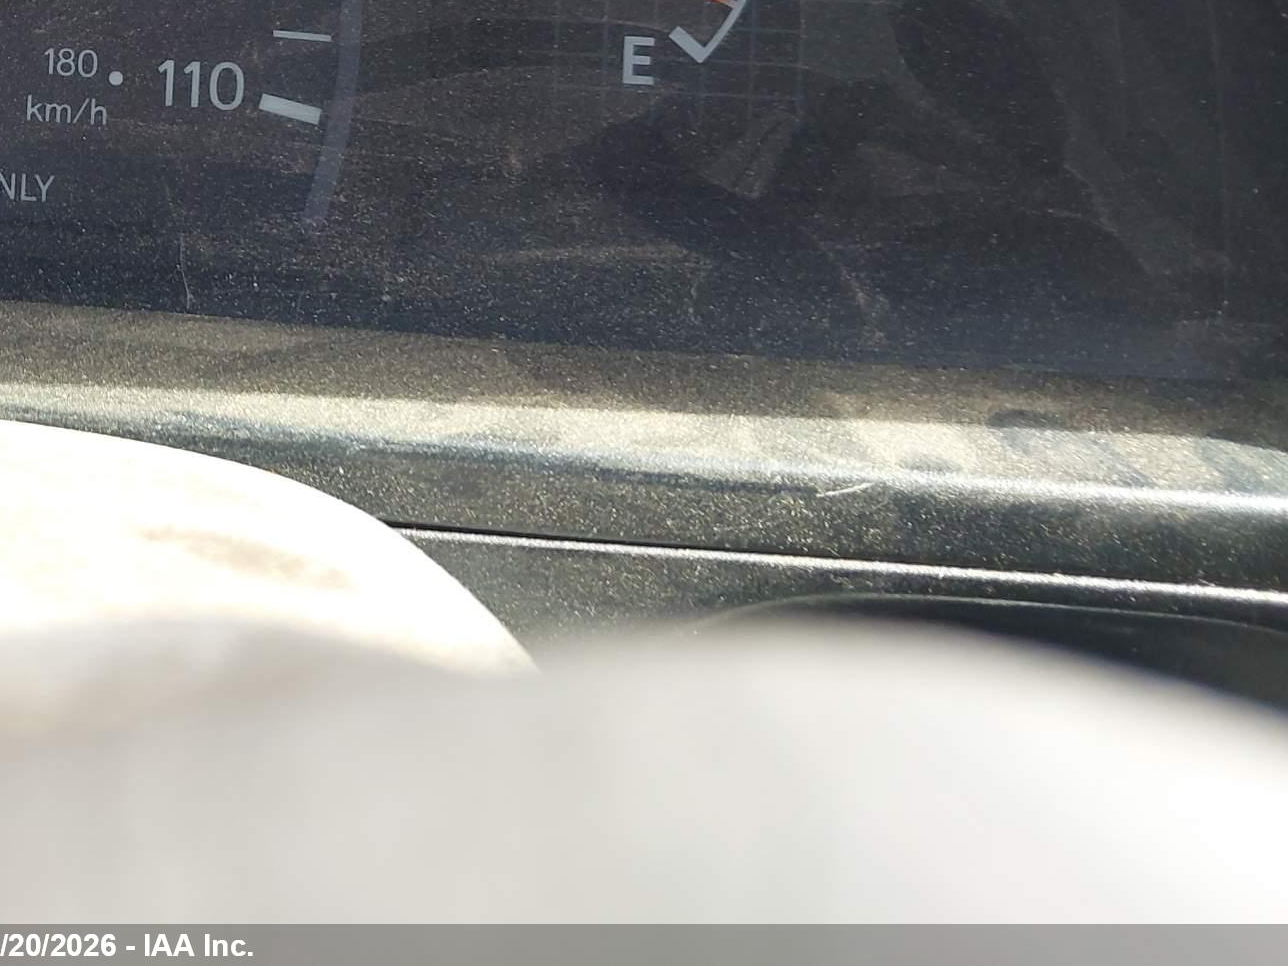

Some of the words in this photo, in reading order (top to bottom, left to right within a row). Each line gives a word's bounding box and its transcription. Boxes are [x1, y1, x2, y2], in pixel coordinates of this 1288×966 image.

[45, 48, 97, 77] 180
[623, 36, 655, 85] E
[159, 60, 244, 110] 110
[27, 95, 107, 125] km/h
